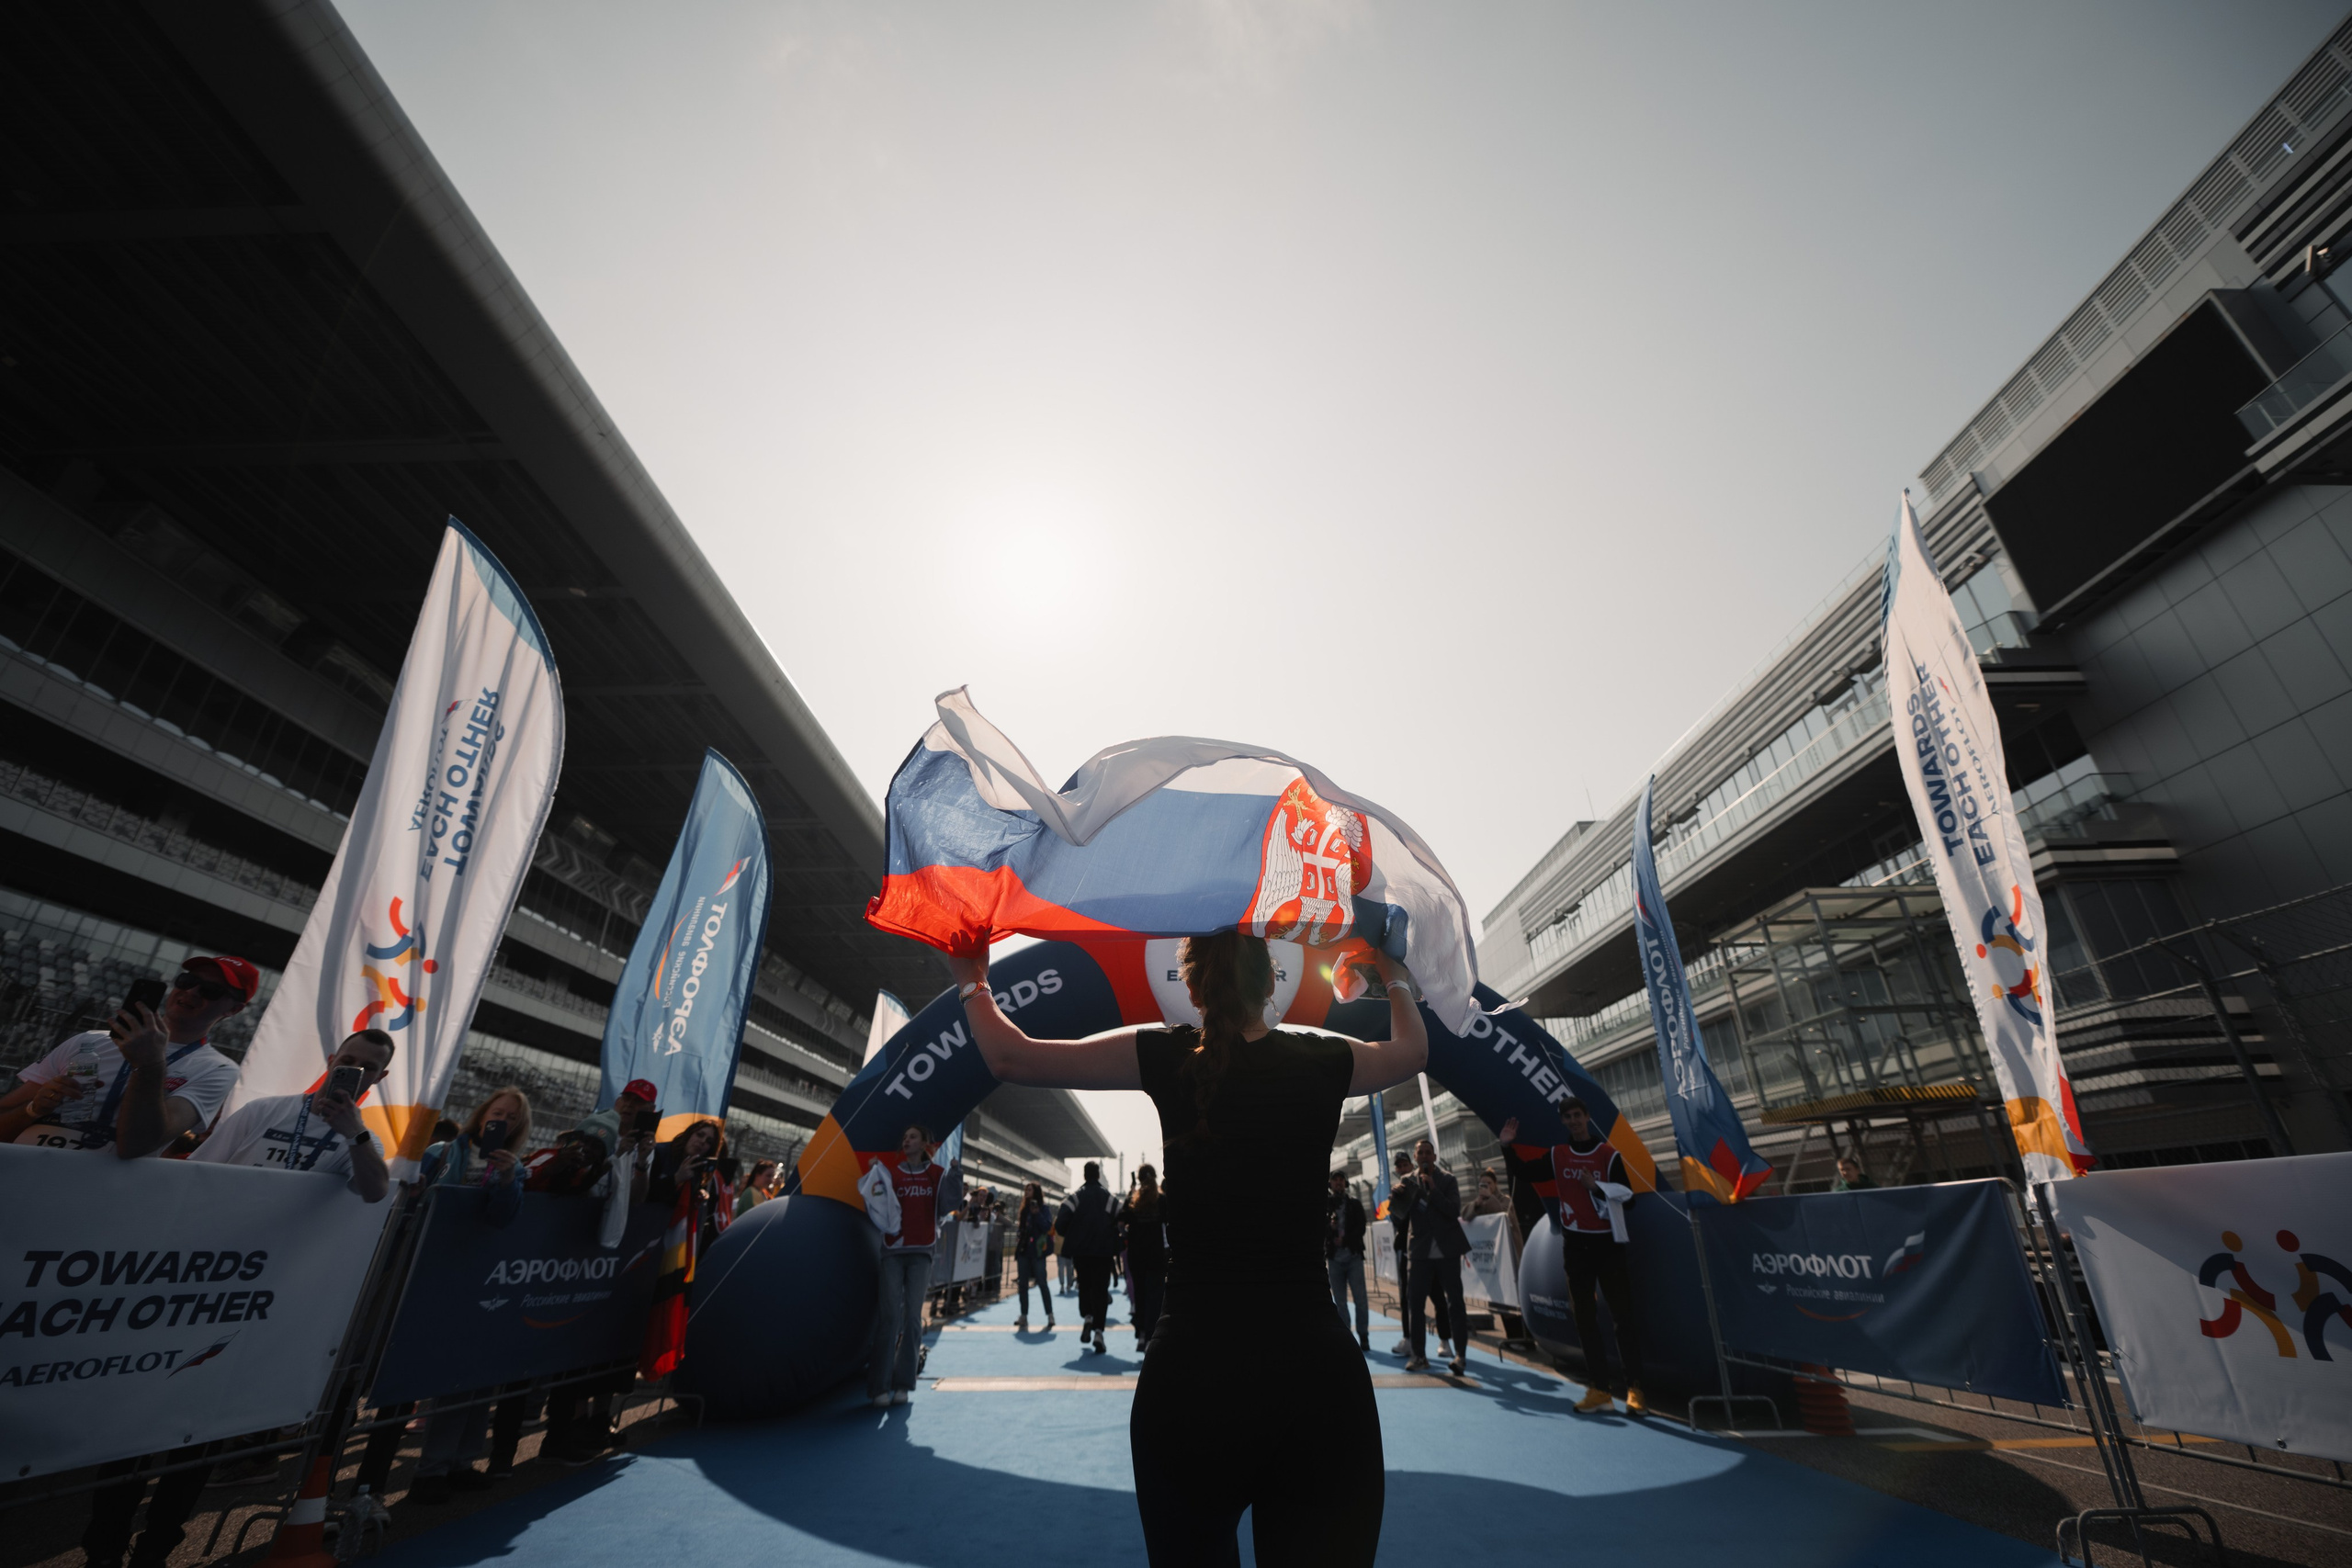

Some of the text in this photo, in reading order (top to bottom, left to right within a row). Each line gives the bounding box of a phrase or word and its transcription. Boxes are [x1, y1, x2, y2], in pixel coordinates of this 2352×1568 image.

[1906, 693, 1964, 857] TOWARDS
[1917, 660, 1996, 866] EACH OTHER
[884, 969, 1063, 1100] TOWRDS
[1645, 936, 1689, 1100] АЭРОФЛОТ
[897, 1185, 933, 1198] СУДЬЯ
[1563, 1168, 1601, 1181] СУЯ
[24, 1250, 268, 1287] TOWARDS
[484, 1257, 619, 1285] АЭРОФЛОТ
[1752, 1253, 1872, 1279] АЭРОФЛОТ
[520, 1292, 571, 1309] Российские
[1786, 1283, 1884, 1303] Российские авиалинии
[0, 1291, 274, 1338] ACH OTHER
[0, 1349, 183, 1387] AEROFLOT
